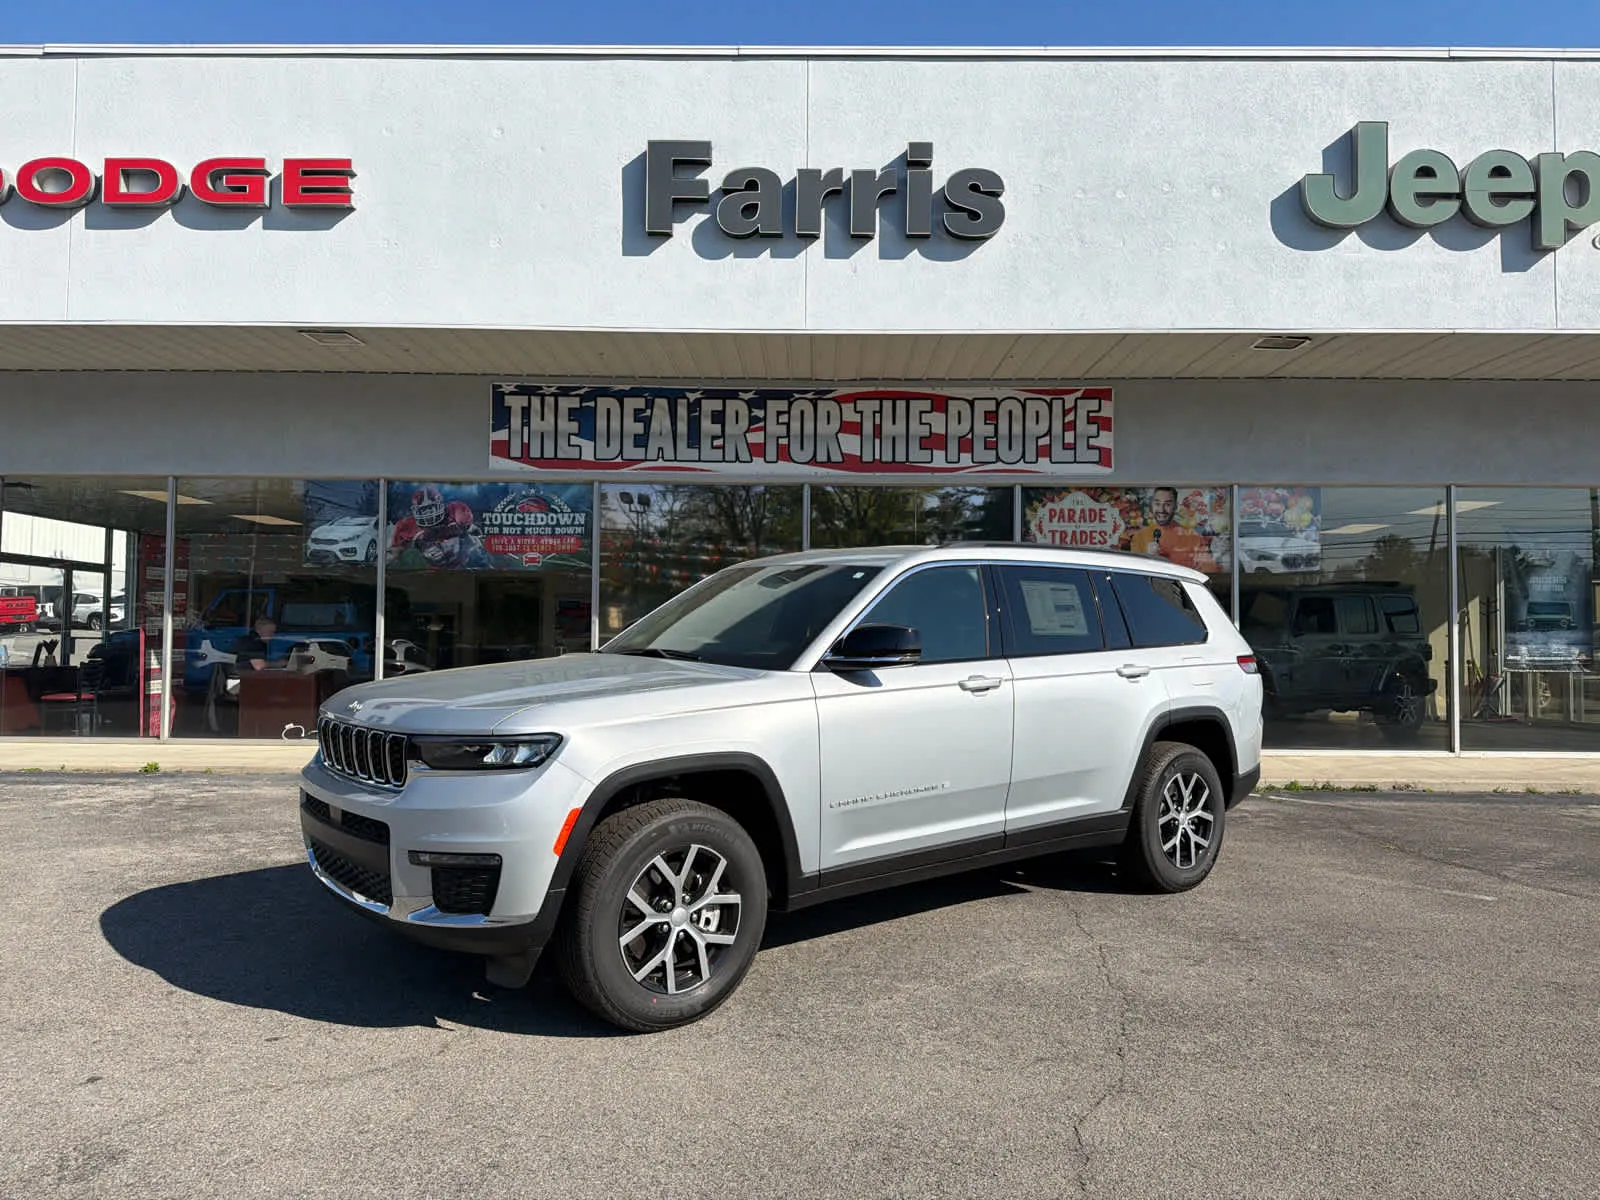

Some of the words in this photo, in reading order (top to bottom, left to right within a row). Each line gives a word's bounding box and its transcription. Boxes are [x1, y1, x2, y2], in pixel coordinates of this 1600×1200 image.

[0, 157, 355, 208] ODGE
[645, 139, 1006, 241] Farris
[1301, 121, 1600, 249] Jeep
[504, 395, 583, 460] THE
[594, 396, 753, 464] DEALER
[763, 397, 845, 464] FOR
[854, 397, 934, 464] THE
[945, 397, 1101, 465] PEOPLE
[483, 512, 586, 526] TOUCHDOWN
[484, 526, 500, 535] FOR
[502, 526, 522, 535] NOT
[525, 526, 552, 535] MUCH
[554, 526, 585, 535] DOWN!
[1048, 507, 1108, 524] PARADE
[1048, 529, 1109, 546] TRADES
